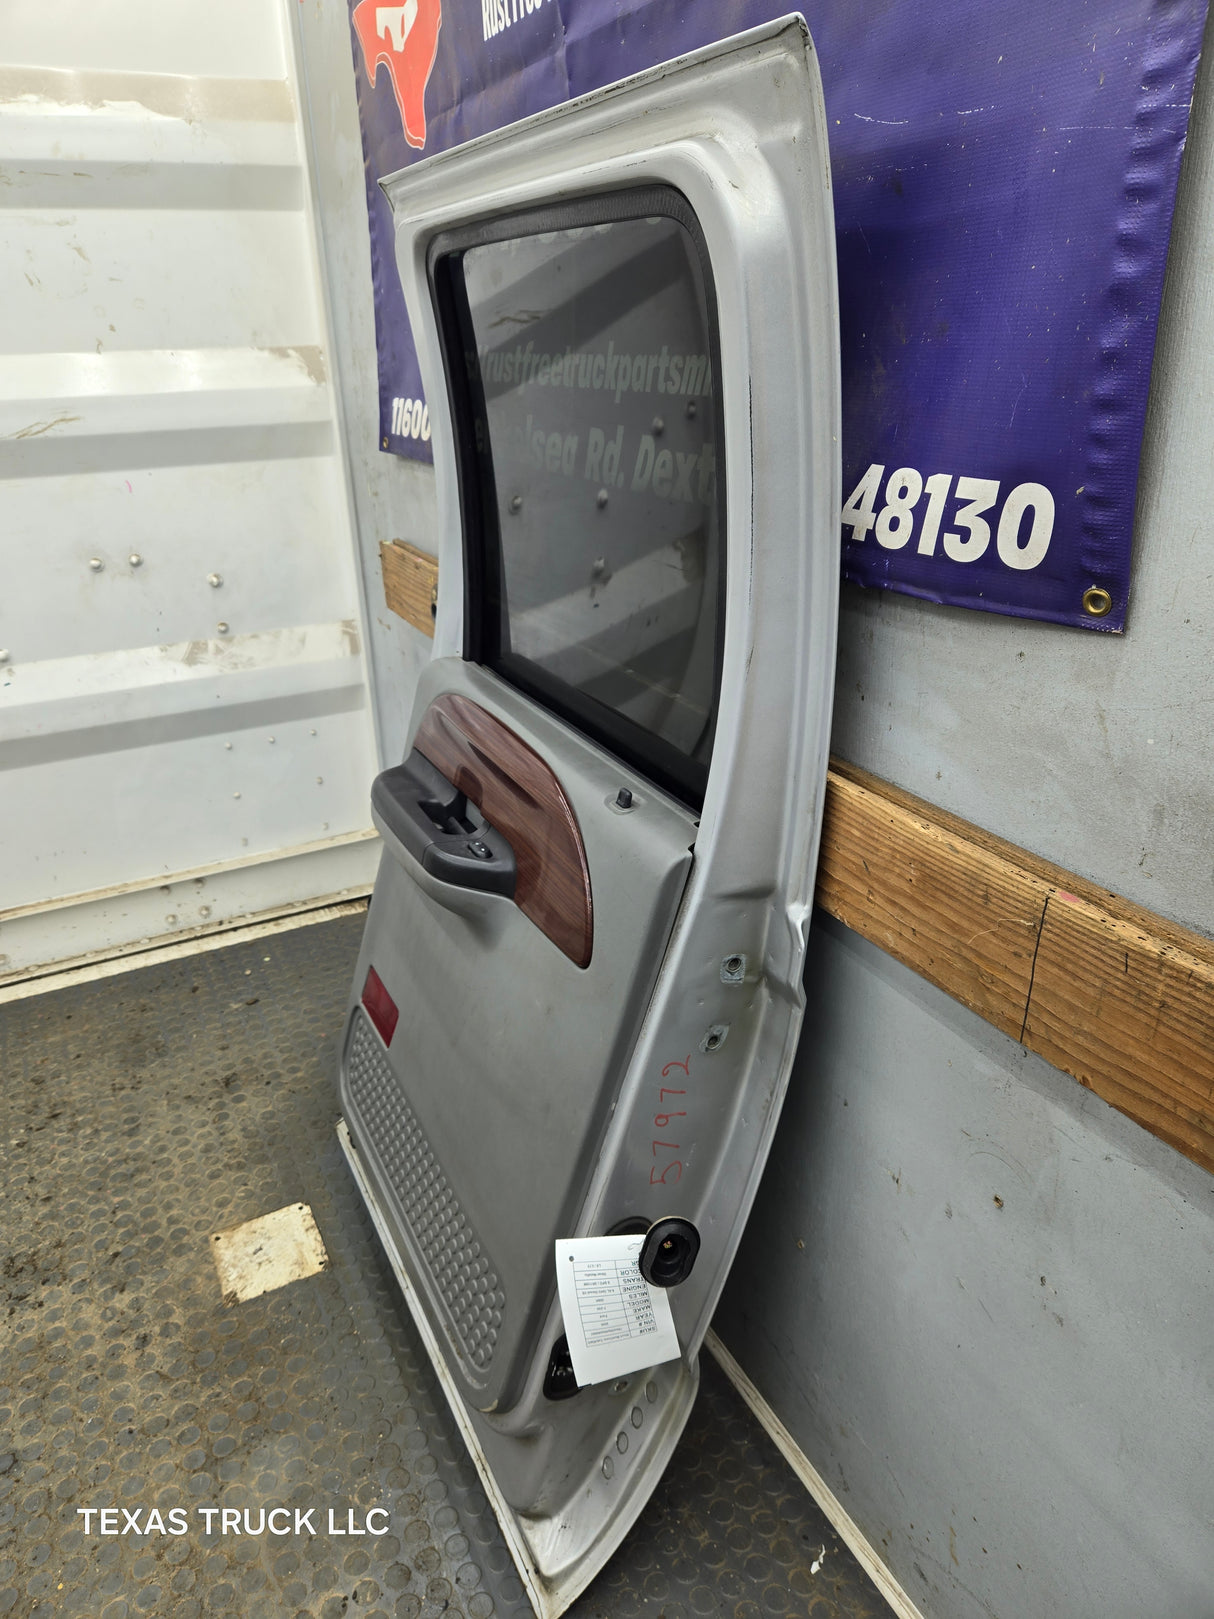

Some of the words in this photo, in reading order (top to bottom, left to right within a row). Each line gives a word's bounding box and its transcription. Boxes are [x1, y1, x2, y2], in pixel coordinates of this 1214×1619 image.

[584, 427, 625, 488] Rd.
[841, 463, 1056, 571] 48130
[650, 1054, 691, 1185] 57972
[622, 1276, 645, 1284] TRANS
[622, 1283, 647, 1293] ENGINE
[628, 1291, 648, 1300] MILES
[627, 1298, 650, 1307] MODEL
[633, 1304, 651, 1313] MAKE
[635, 1312, 652, 1320] YEAR
